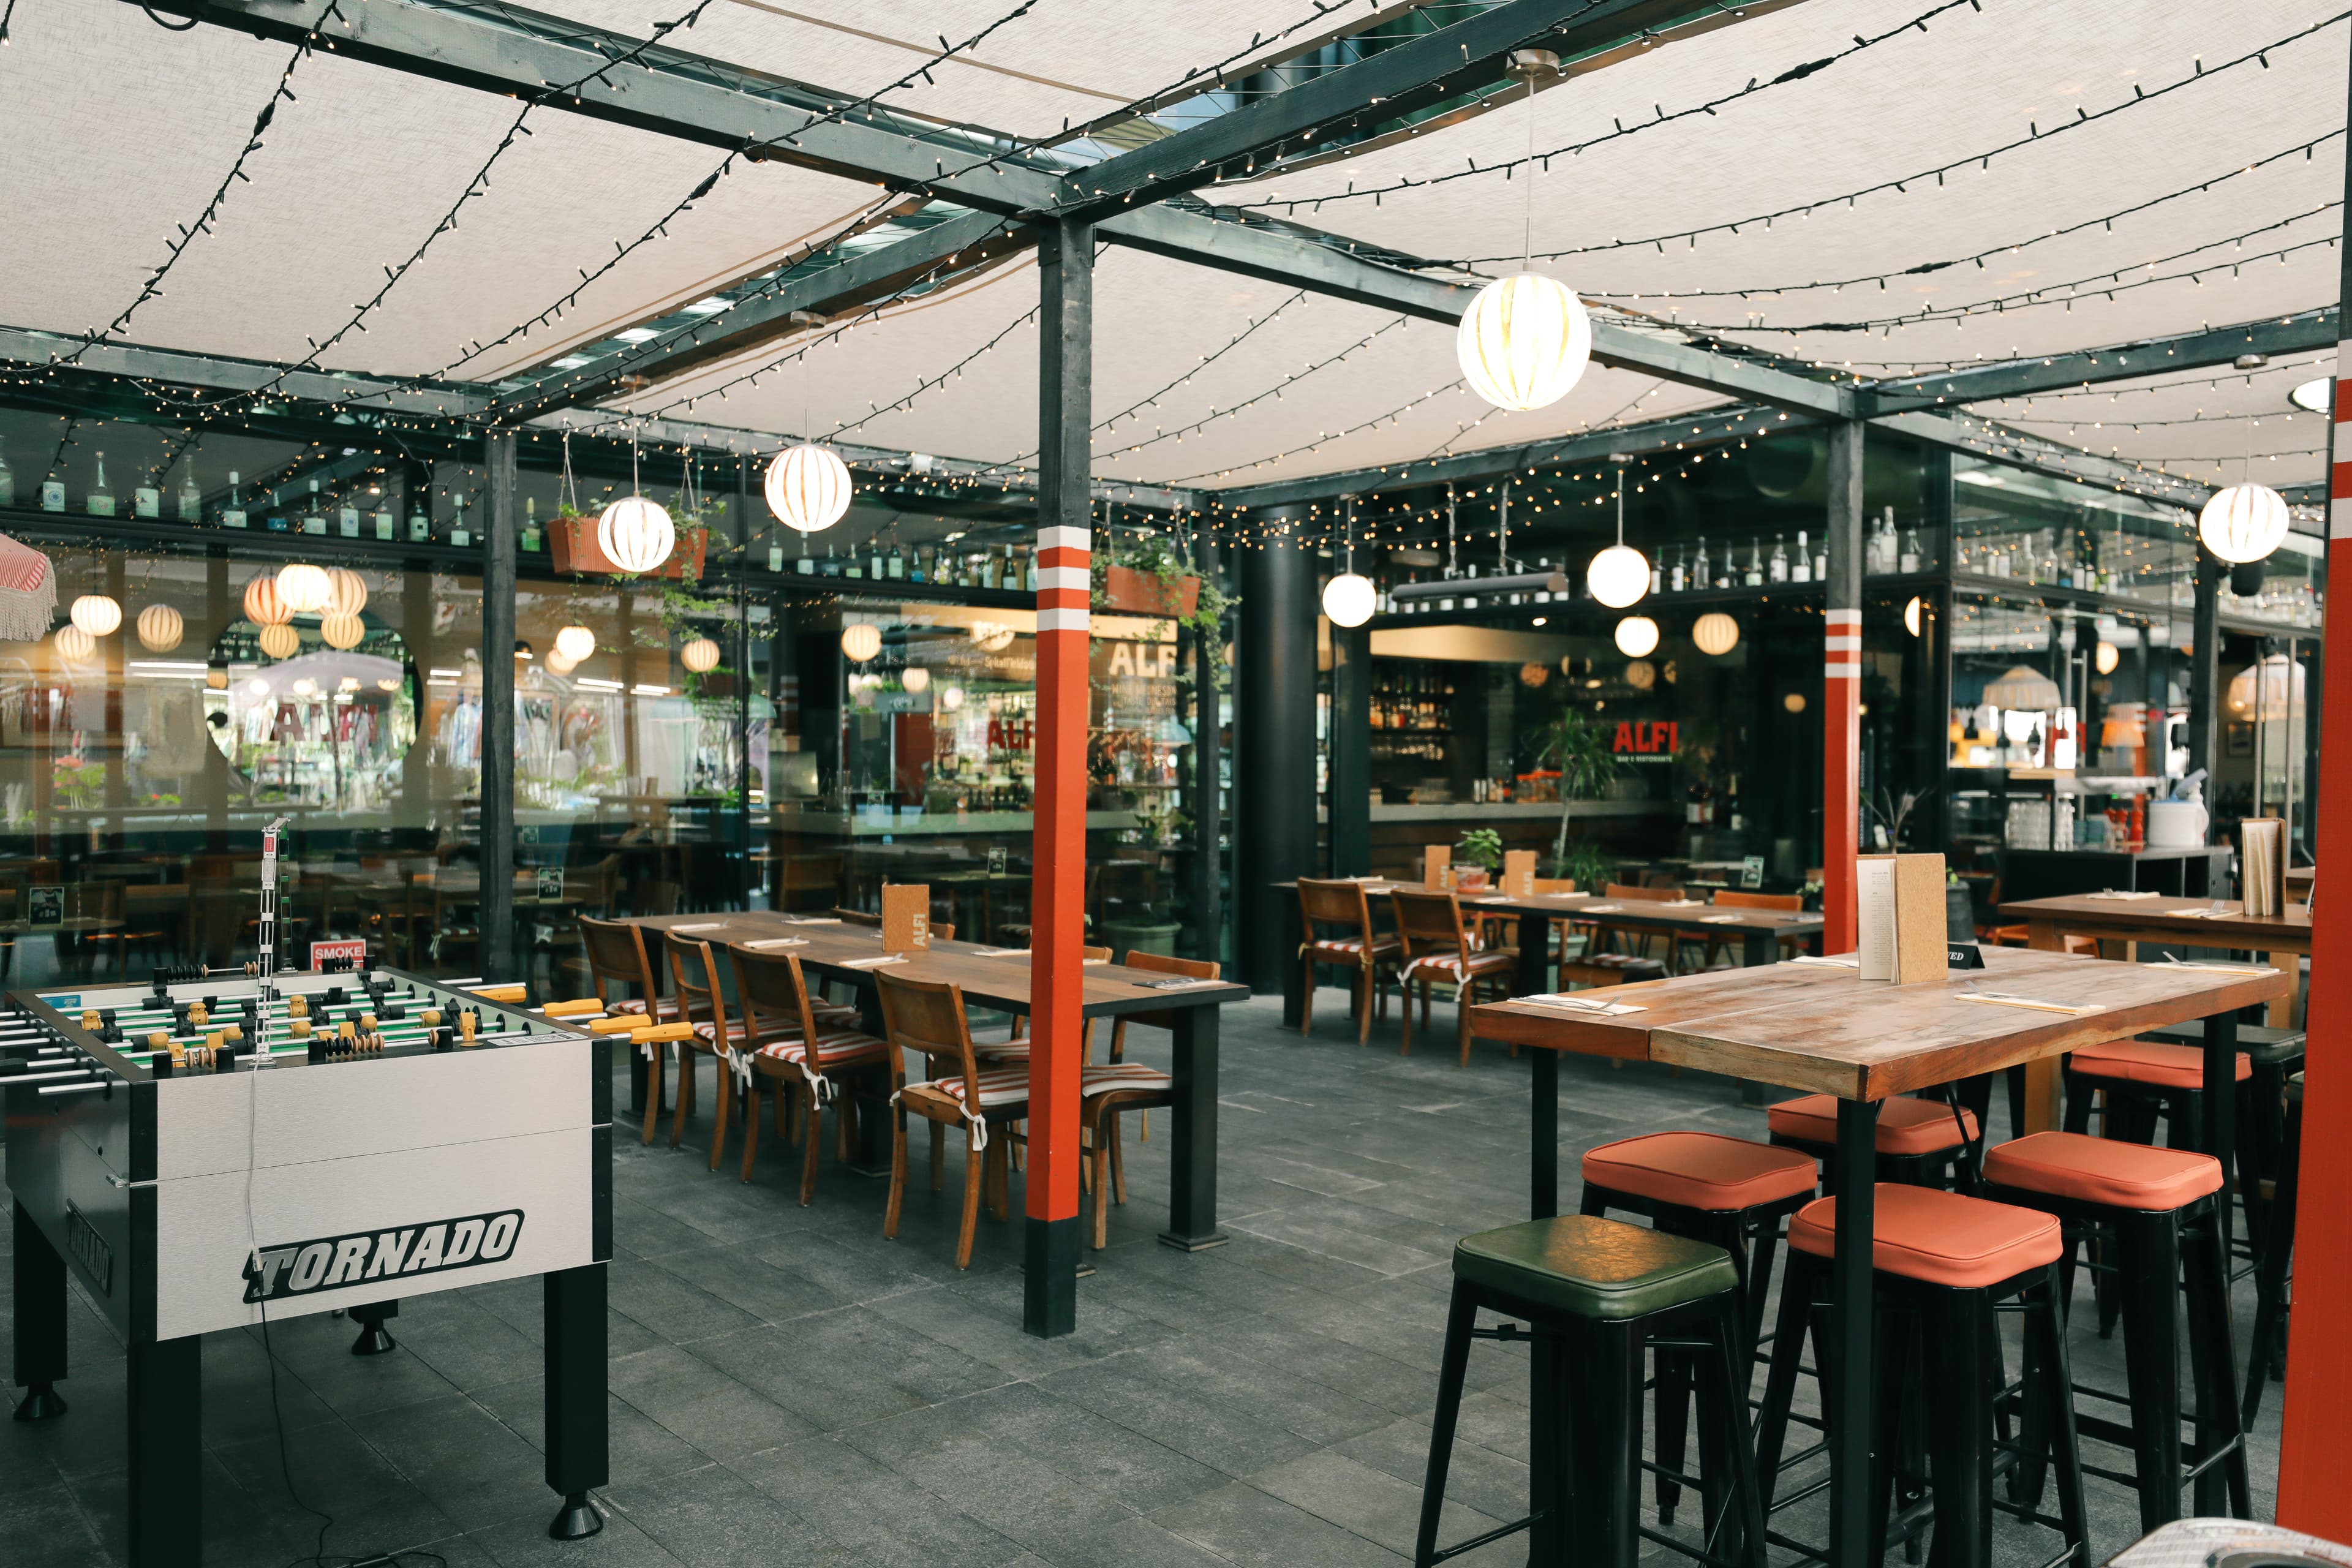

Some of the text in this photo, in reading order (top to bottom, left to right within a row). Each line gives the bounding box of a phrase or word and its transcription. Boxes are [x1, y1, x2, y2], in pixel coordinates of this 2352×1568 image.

[1613, 722, 1678, 753] ALFI
[913, 913, 926, 947] ALFI
[315, 946, 363, 960] SMOKE
[250, 1213, 519, 1297] TORNADO
